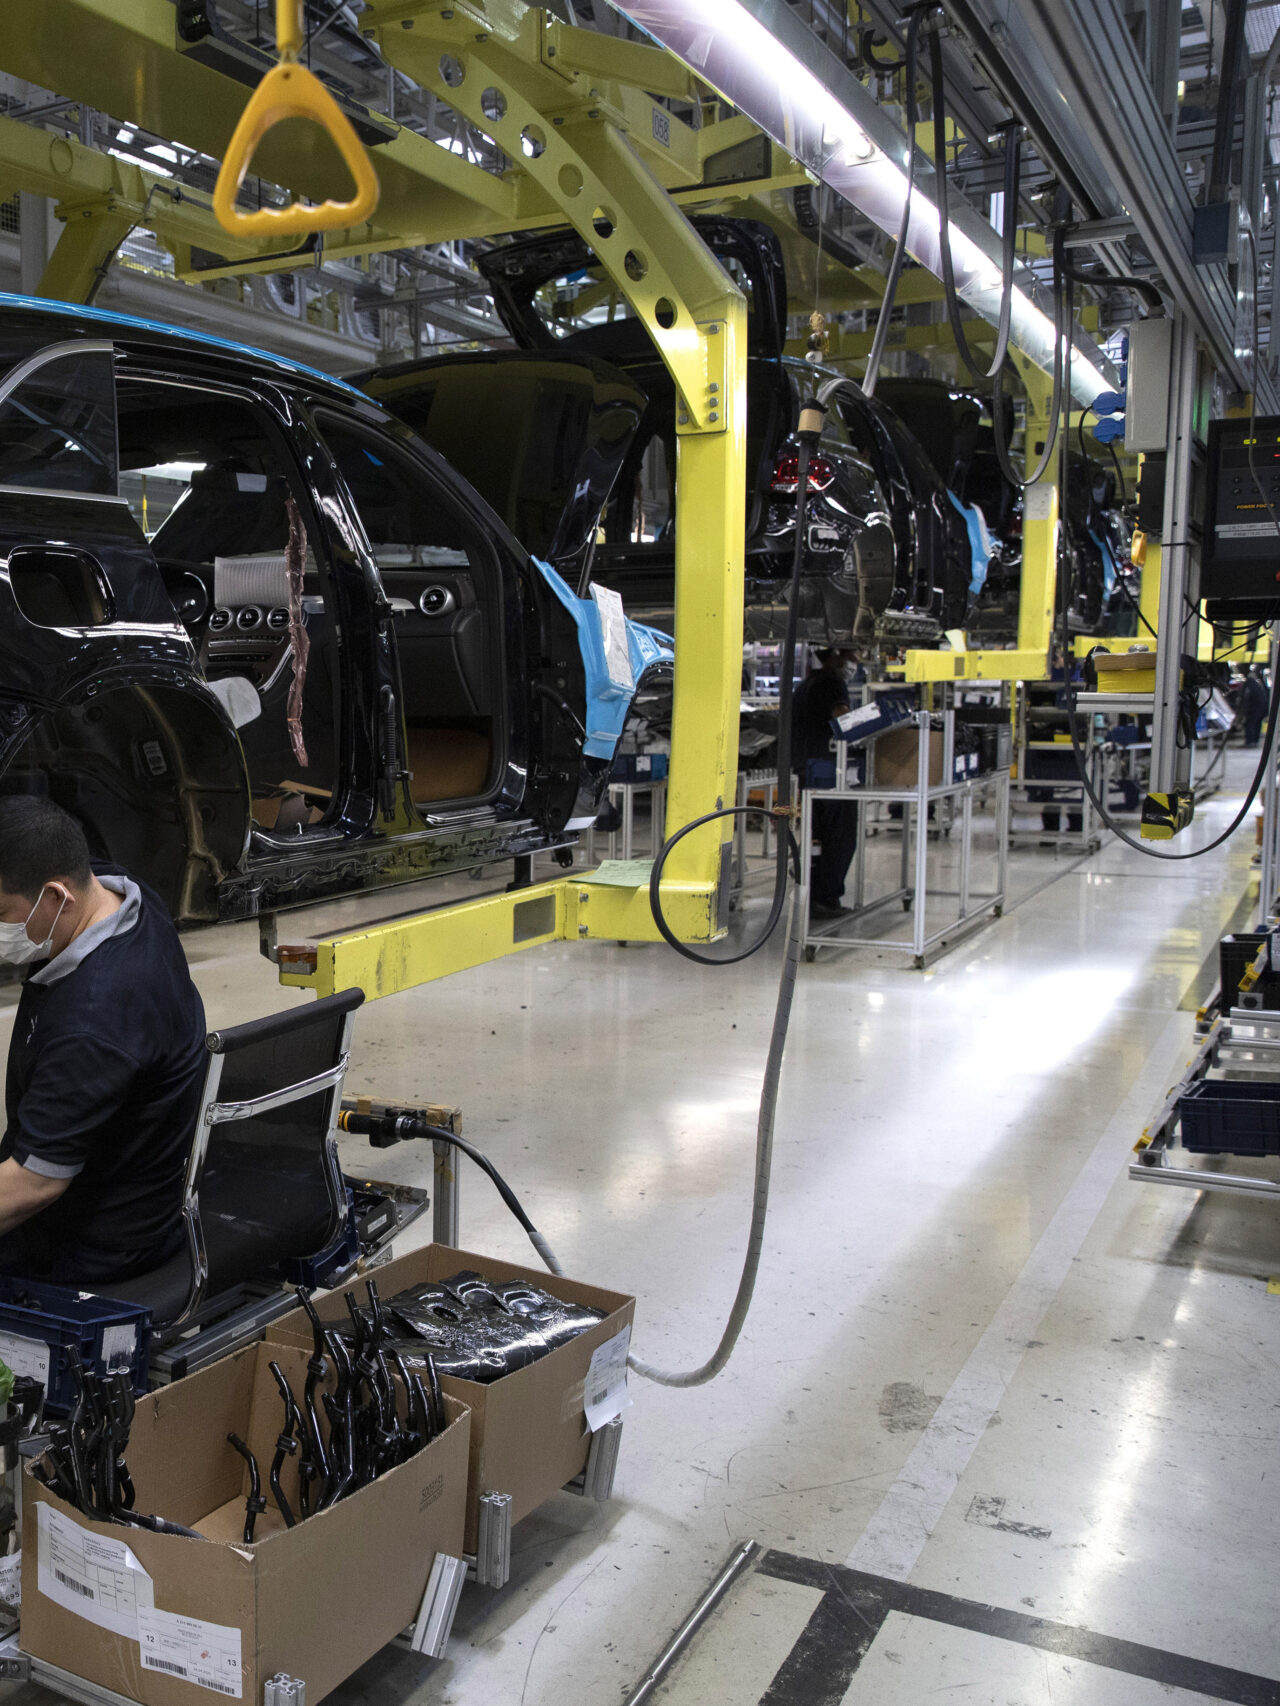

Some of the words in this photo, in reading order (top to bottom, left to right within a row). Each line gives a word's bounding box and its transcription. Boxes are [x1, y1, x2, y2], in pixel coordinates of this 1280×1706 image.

[654, 114, 668, 142] 058
[146, 1634, 155, 1643] 12
[227, 1659, 237, 1667] 13
